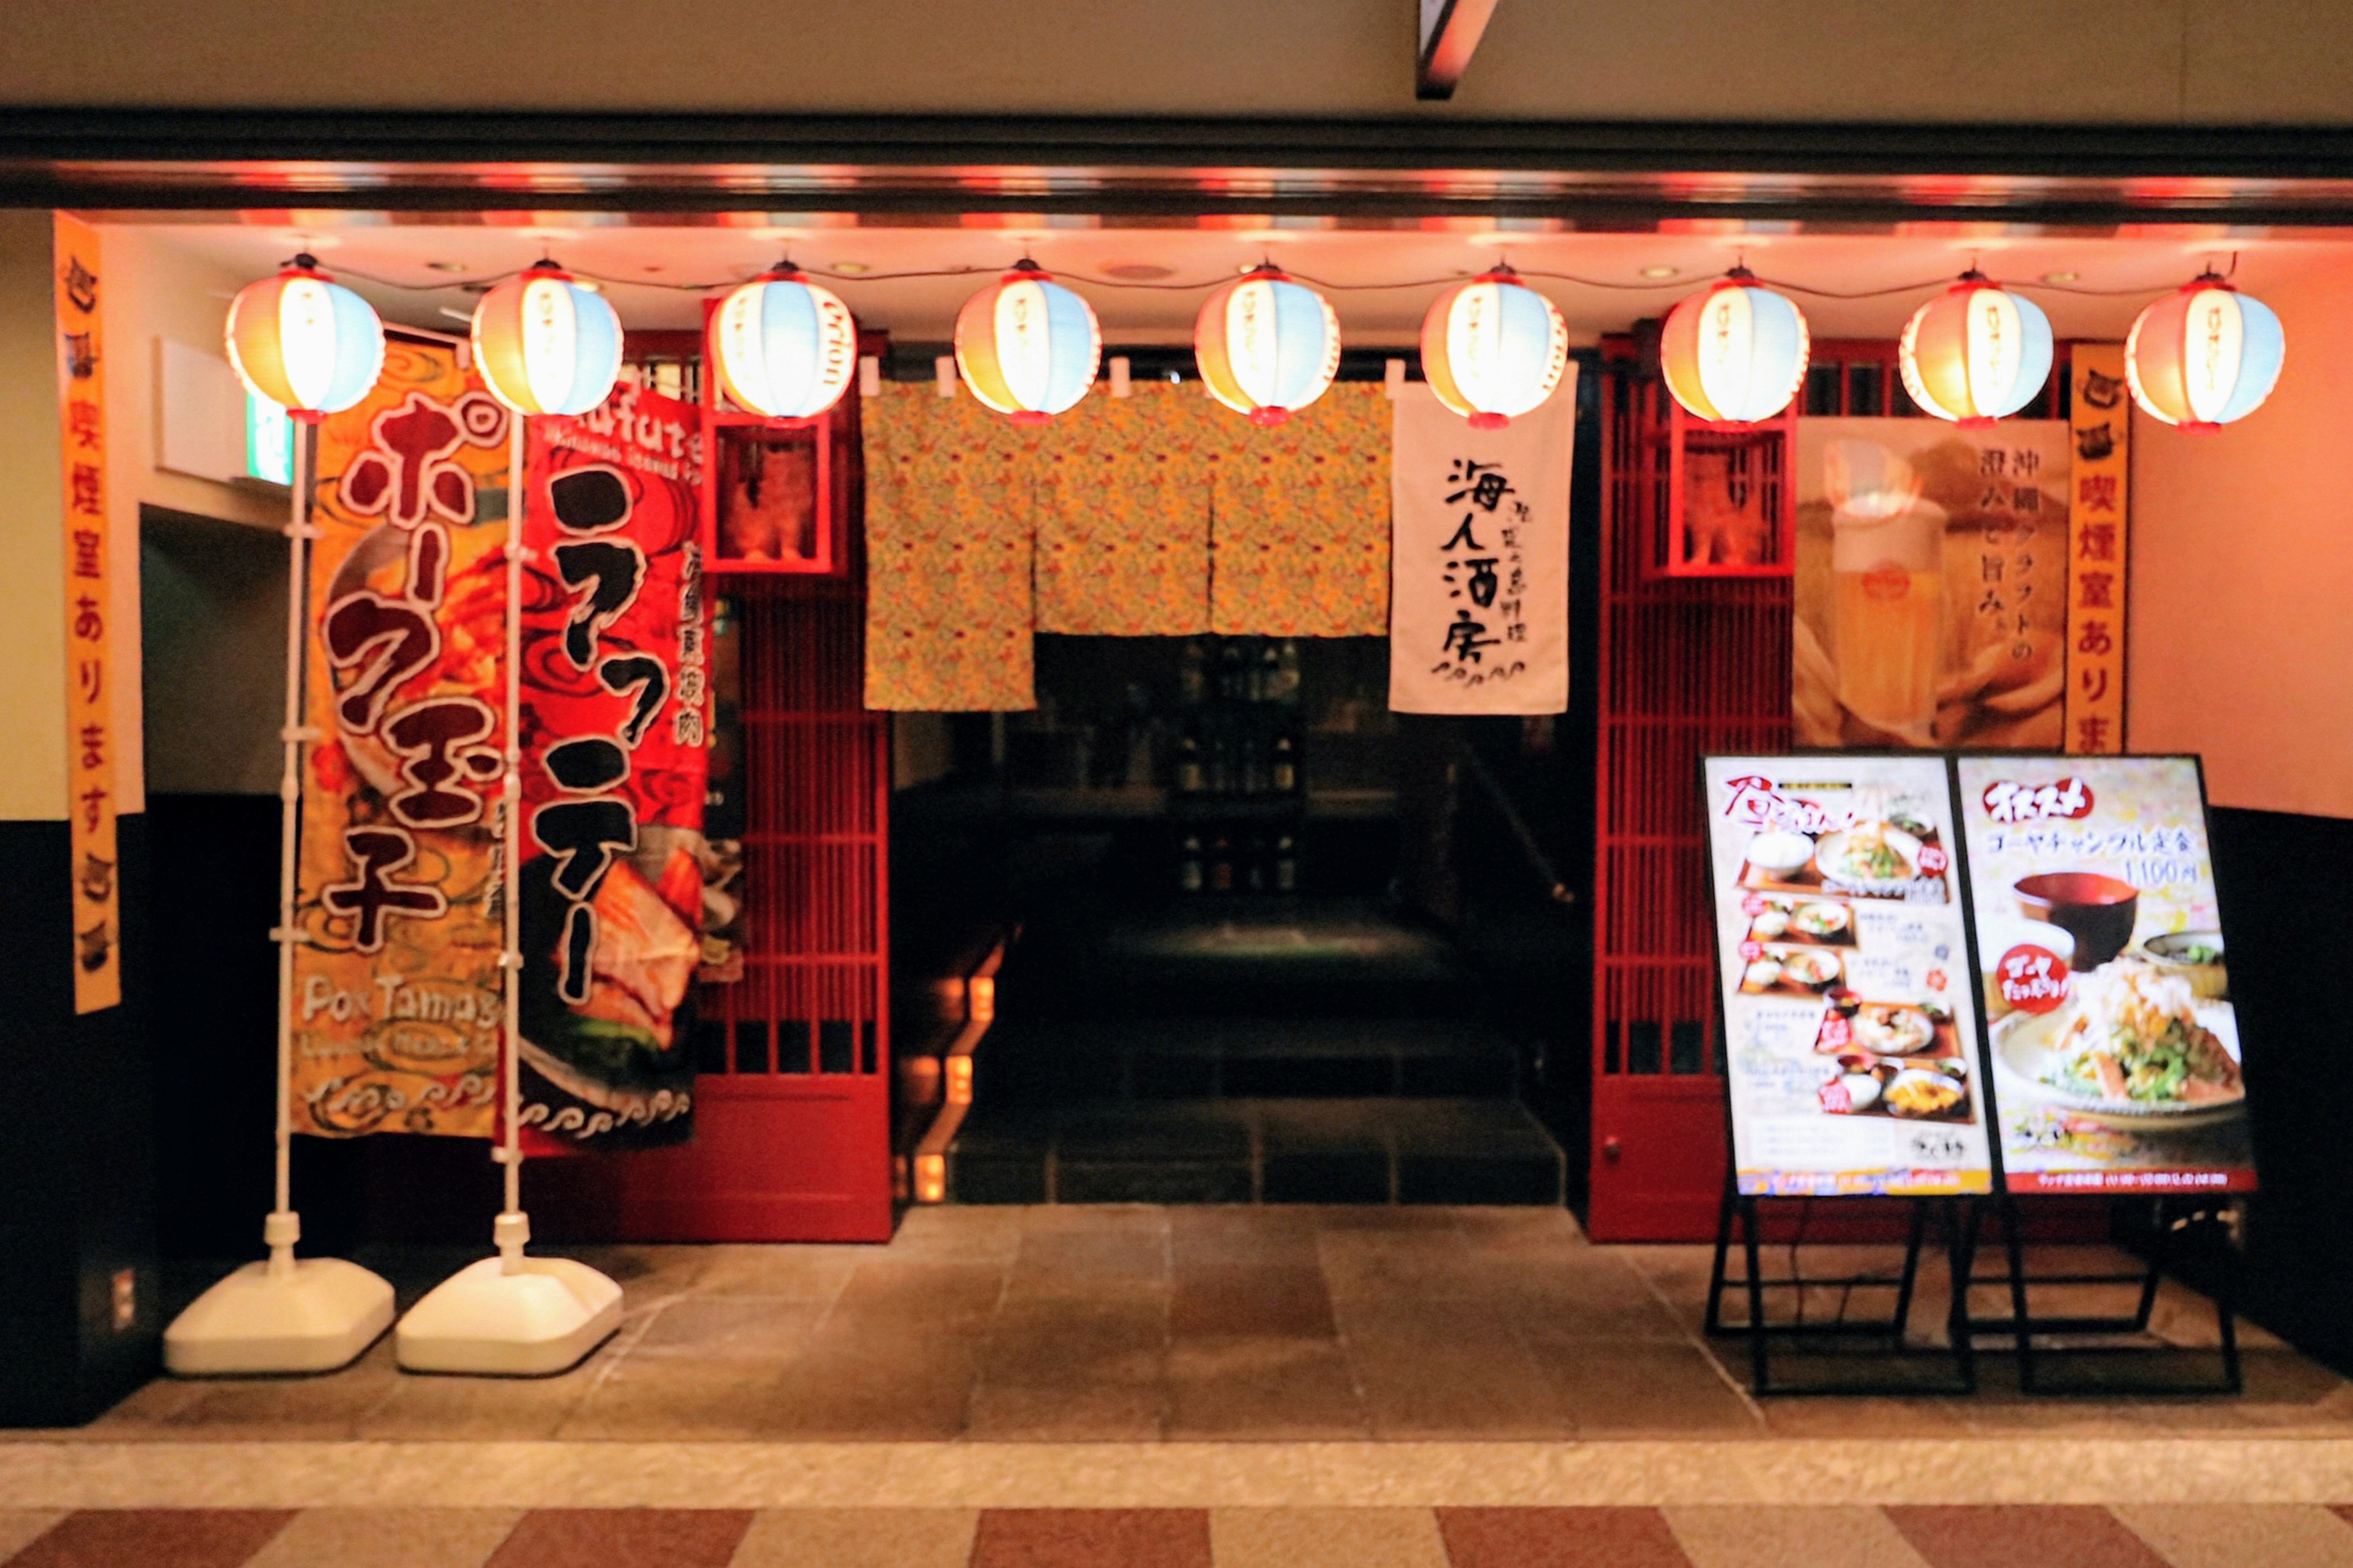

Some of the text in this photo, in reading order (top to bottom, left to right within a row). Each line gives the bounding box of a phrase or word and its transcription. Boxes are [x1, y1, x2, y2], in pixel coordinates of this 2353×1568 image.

[1439, 459, 1516, 664] 海人酒房
[1985, 777, 2087, 824] オススメ
